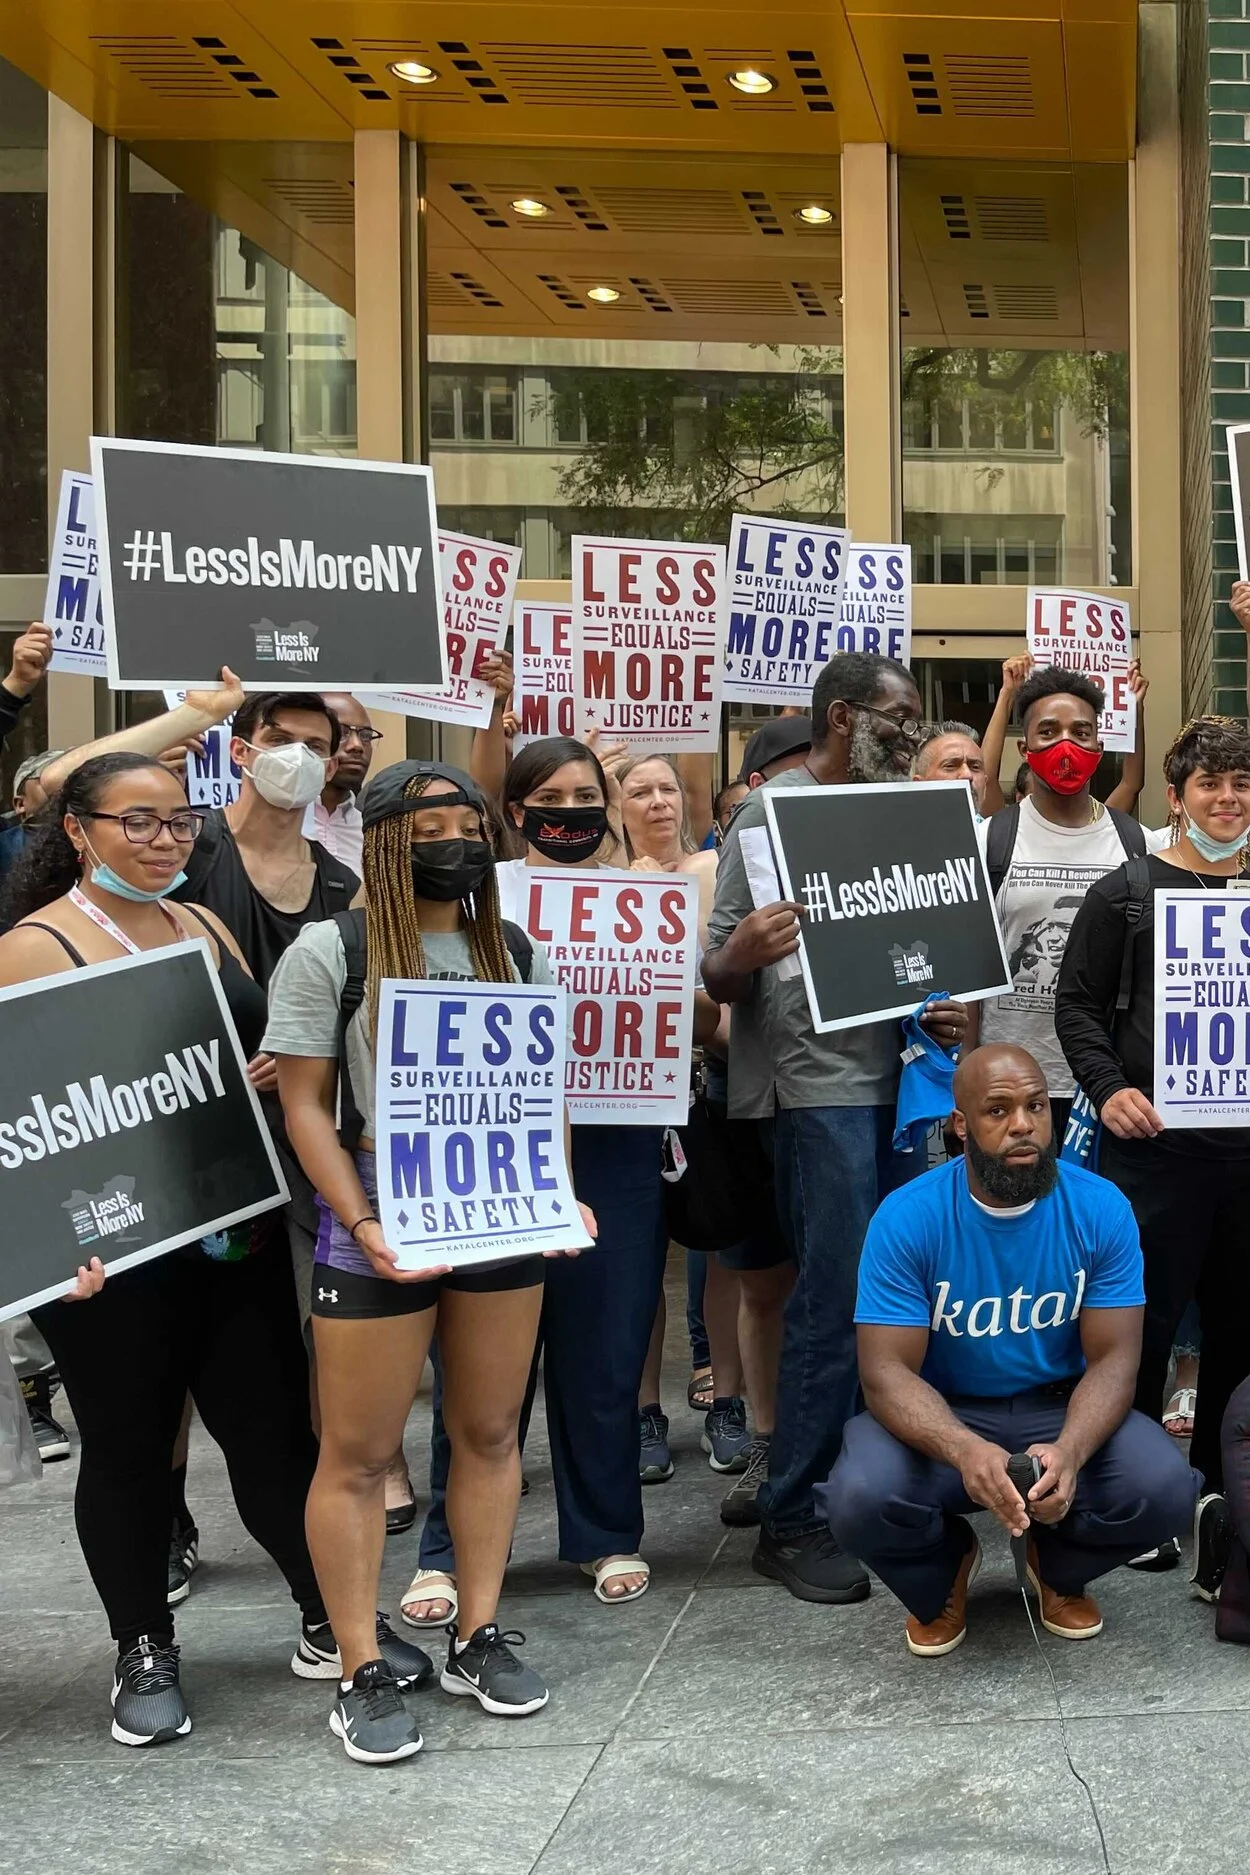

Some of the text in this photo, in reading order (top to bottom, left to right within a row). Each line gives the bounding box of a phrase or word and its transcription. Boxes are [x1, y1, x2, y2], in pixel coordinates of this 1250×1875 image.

[123, 530, 422, 593] #LessIsMoreNY
[736, 528, 841, 581] LESS
[439, 544, 509, 598] SS
[583, 552, 716, 606] LESS
[735, 574, 837, 595] SURVEILLANCE
[845, 554, 904, 591] SS
[755, 591, 817, 616] EQUALS
[843, 591, 904, 604] EILLANCE
[583, 606, 716, 623] SURVEILLANCE
[1034, 599, 1126, 641] LESS
[274, 630, 309, 646] Less Is
[523, 614, 572, 655] LE
[611, 623, 690, 650] EQUALS
[728, 612, 832, 662] MORE
[838, 625, 904, 664] ORE
[1034, 638, 1127, 653] SURVEILLANCE
[275, 646, 302, 661] More
[303, 647, 319, 662] NY
[1053, 651, 1110, 672] EQUALS
[583, 650, 715, 702] MORE
[740, 658, 813, 683] SAFETY
[522, 694, 574, 736] MO
[604, 704, 693, 728] JUSTICE
[1012, 868, 1067, 879] You Can Kill A
[801, 857, 979, 923] #LessIsMoreNY
[528, 884, 686, 945] LESS
[547, 946, 685, 963] RVEILLANCE
[903, 952, 925, 968] Less Is
[558, 965, 652, 995] EQUALS
[907, 967, 924, 983] More
[923, 965, 933, 980] NY
[1015, 984, 1035, 994] red
[391, 999, 555, 1066] LESS
[572, 1000, 682, 1058] ORE
[390, 1071, 554, 1088] SURVEILLANCE
[564, 1061, 654, 1090] USTICE
[0, 1039, 226, 1169] ssIsMoreNY
[424, 1093, 522, 1126] EQUALS
[390, 1129, 558, 1199] MORE
[89, 1191, 130, 1218] Less Is
[96, 1214, 129, 1237] More
[125, 1202, 145, 1225] NY
[421, 1196, 539, 1233] SAFETY
[446, 1236, 535, 1251] KATALCENTER.ORG
[931, 1268, 1085, 1338] katal
